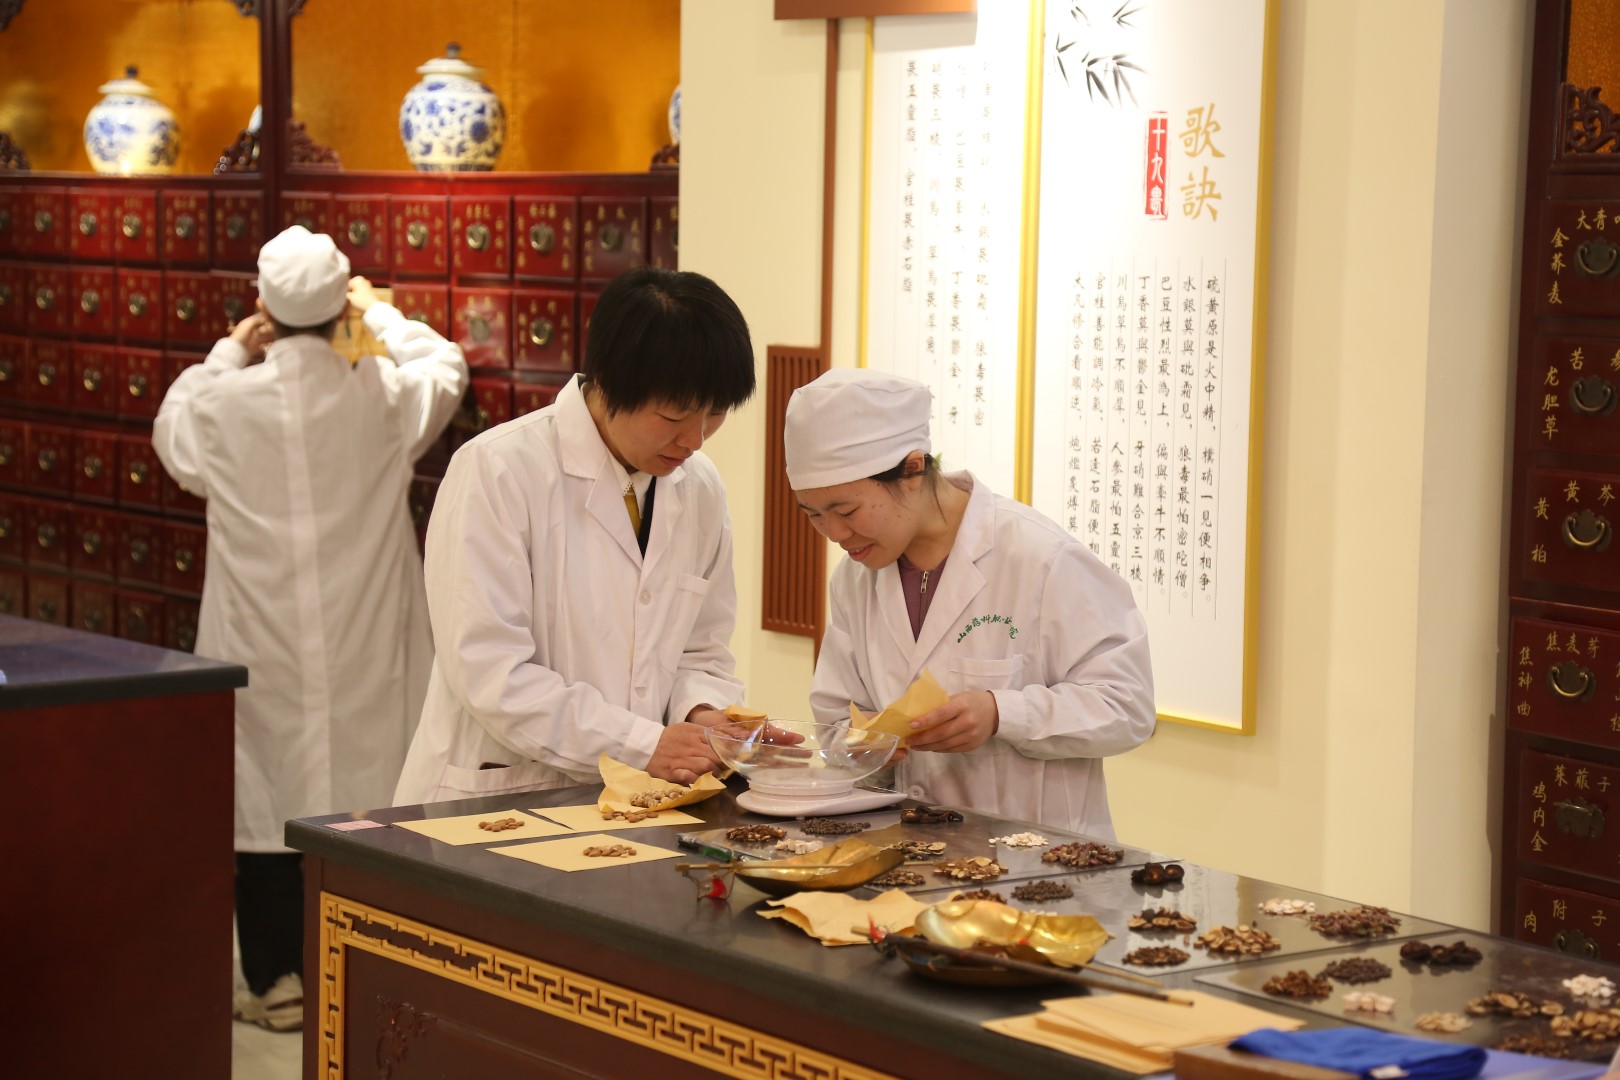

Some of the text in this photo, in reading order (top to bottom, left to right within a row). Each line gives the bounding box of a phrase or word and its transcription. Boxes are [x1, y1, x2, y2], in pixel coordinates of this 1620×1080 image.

[1179, 102, 1226, 222] 歌訣
[1547, 227, 1570, 304] 金荞麦
[1542, 366, 1560, 441] 龙胆草
[1563, 480, 1616, 506] 黄芩
[1531, 497, 1550, 563] 黄柏
[1546, 631, 1601, 658] 焦麦芽
[1517, 646, 1533, 717] 焦神曲
[1554, 763, 1611, 793] 莱菔子
[1530, 781, 1548, 852] 鸡内金
[1524, 910, 1537, 933] 肉
[1553, 899, 1607, 927] 附子
